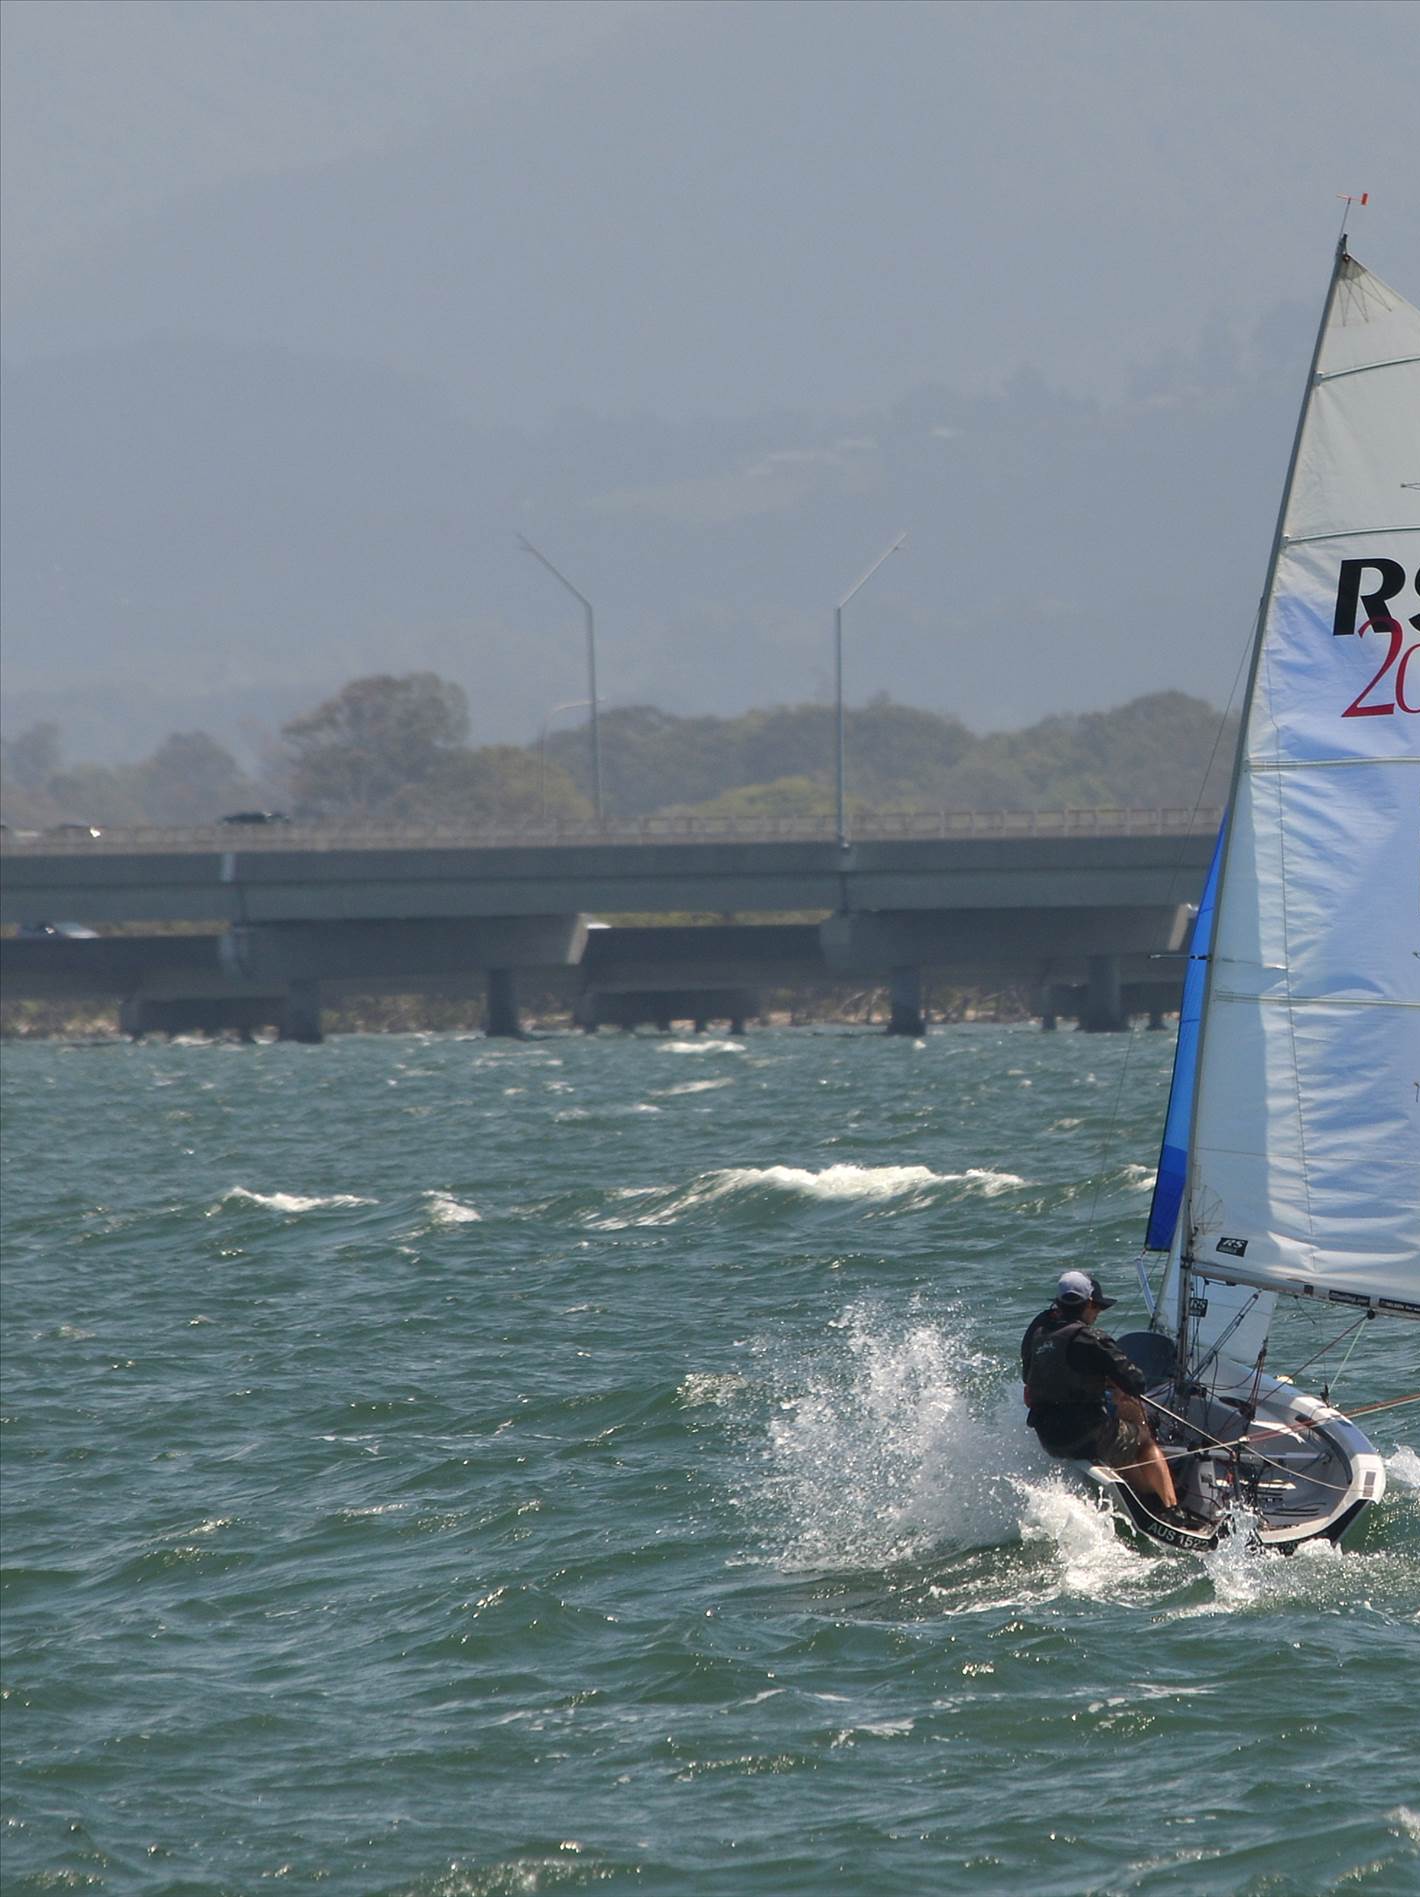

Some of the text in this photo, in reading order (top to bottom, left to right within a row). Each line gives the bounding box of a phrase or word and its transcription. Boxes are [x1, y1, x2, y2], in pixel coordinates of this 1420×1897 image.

[1223, 1239, 1245, 1248] RS
[1190, 1299, 1206, 1310] RS
[1149, 1522, 1209, 1551] AUS 1522
